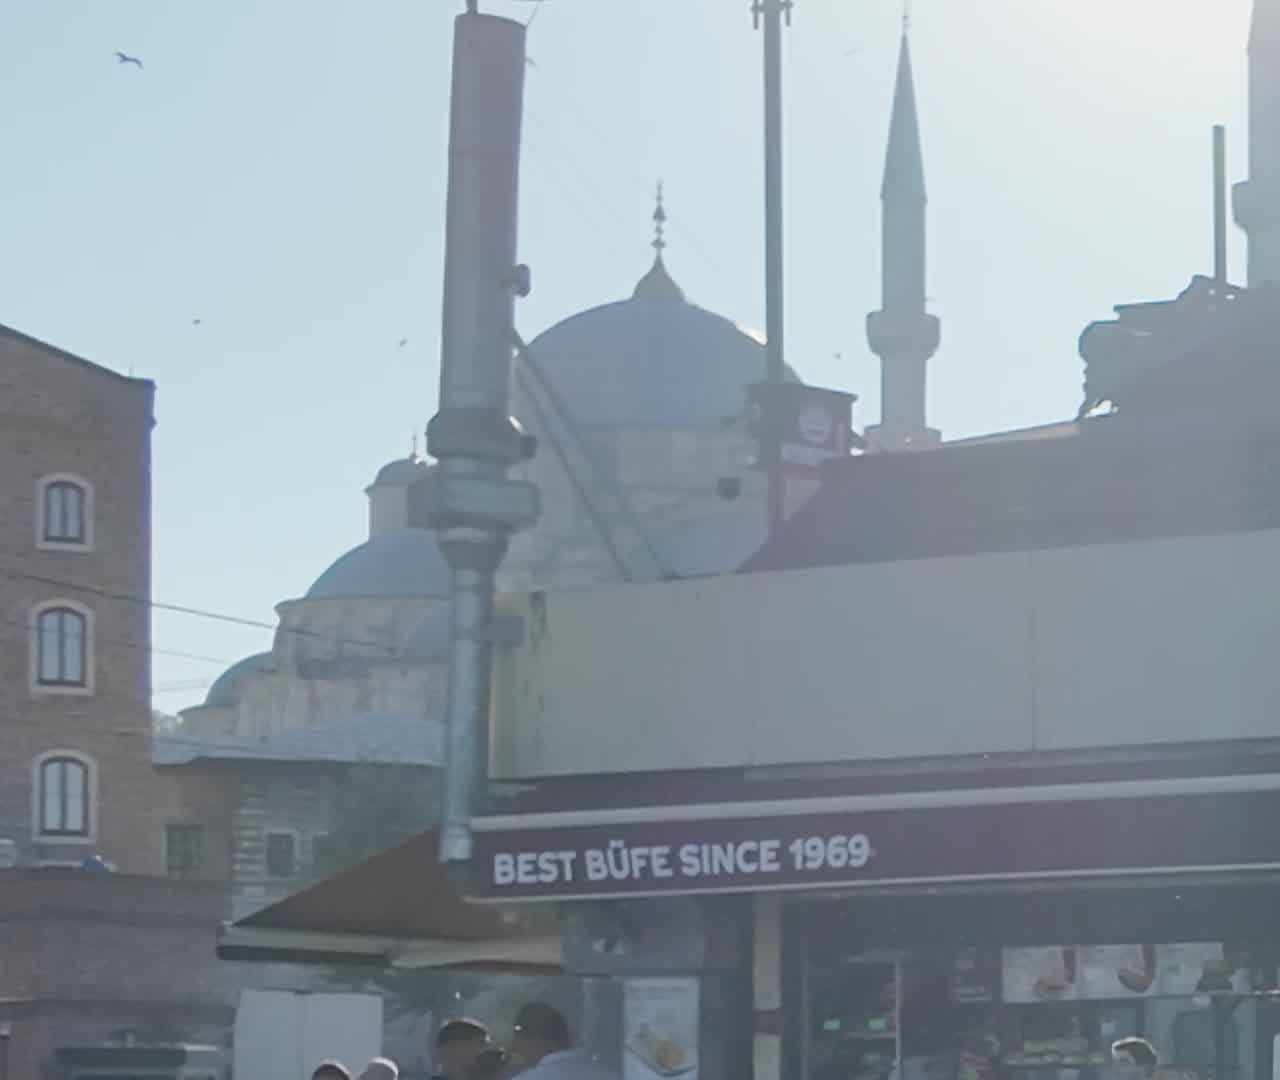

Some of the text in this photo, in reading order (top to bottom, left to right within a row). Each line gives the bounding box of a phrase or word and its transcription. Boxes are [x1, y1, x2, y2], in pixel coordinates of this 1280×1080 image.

[494, 833, 870, 885] BEST BÜFE SINCE 1969
